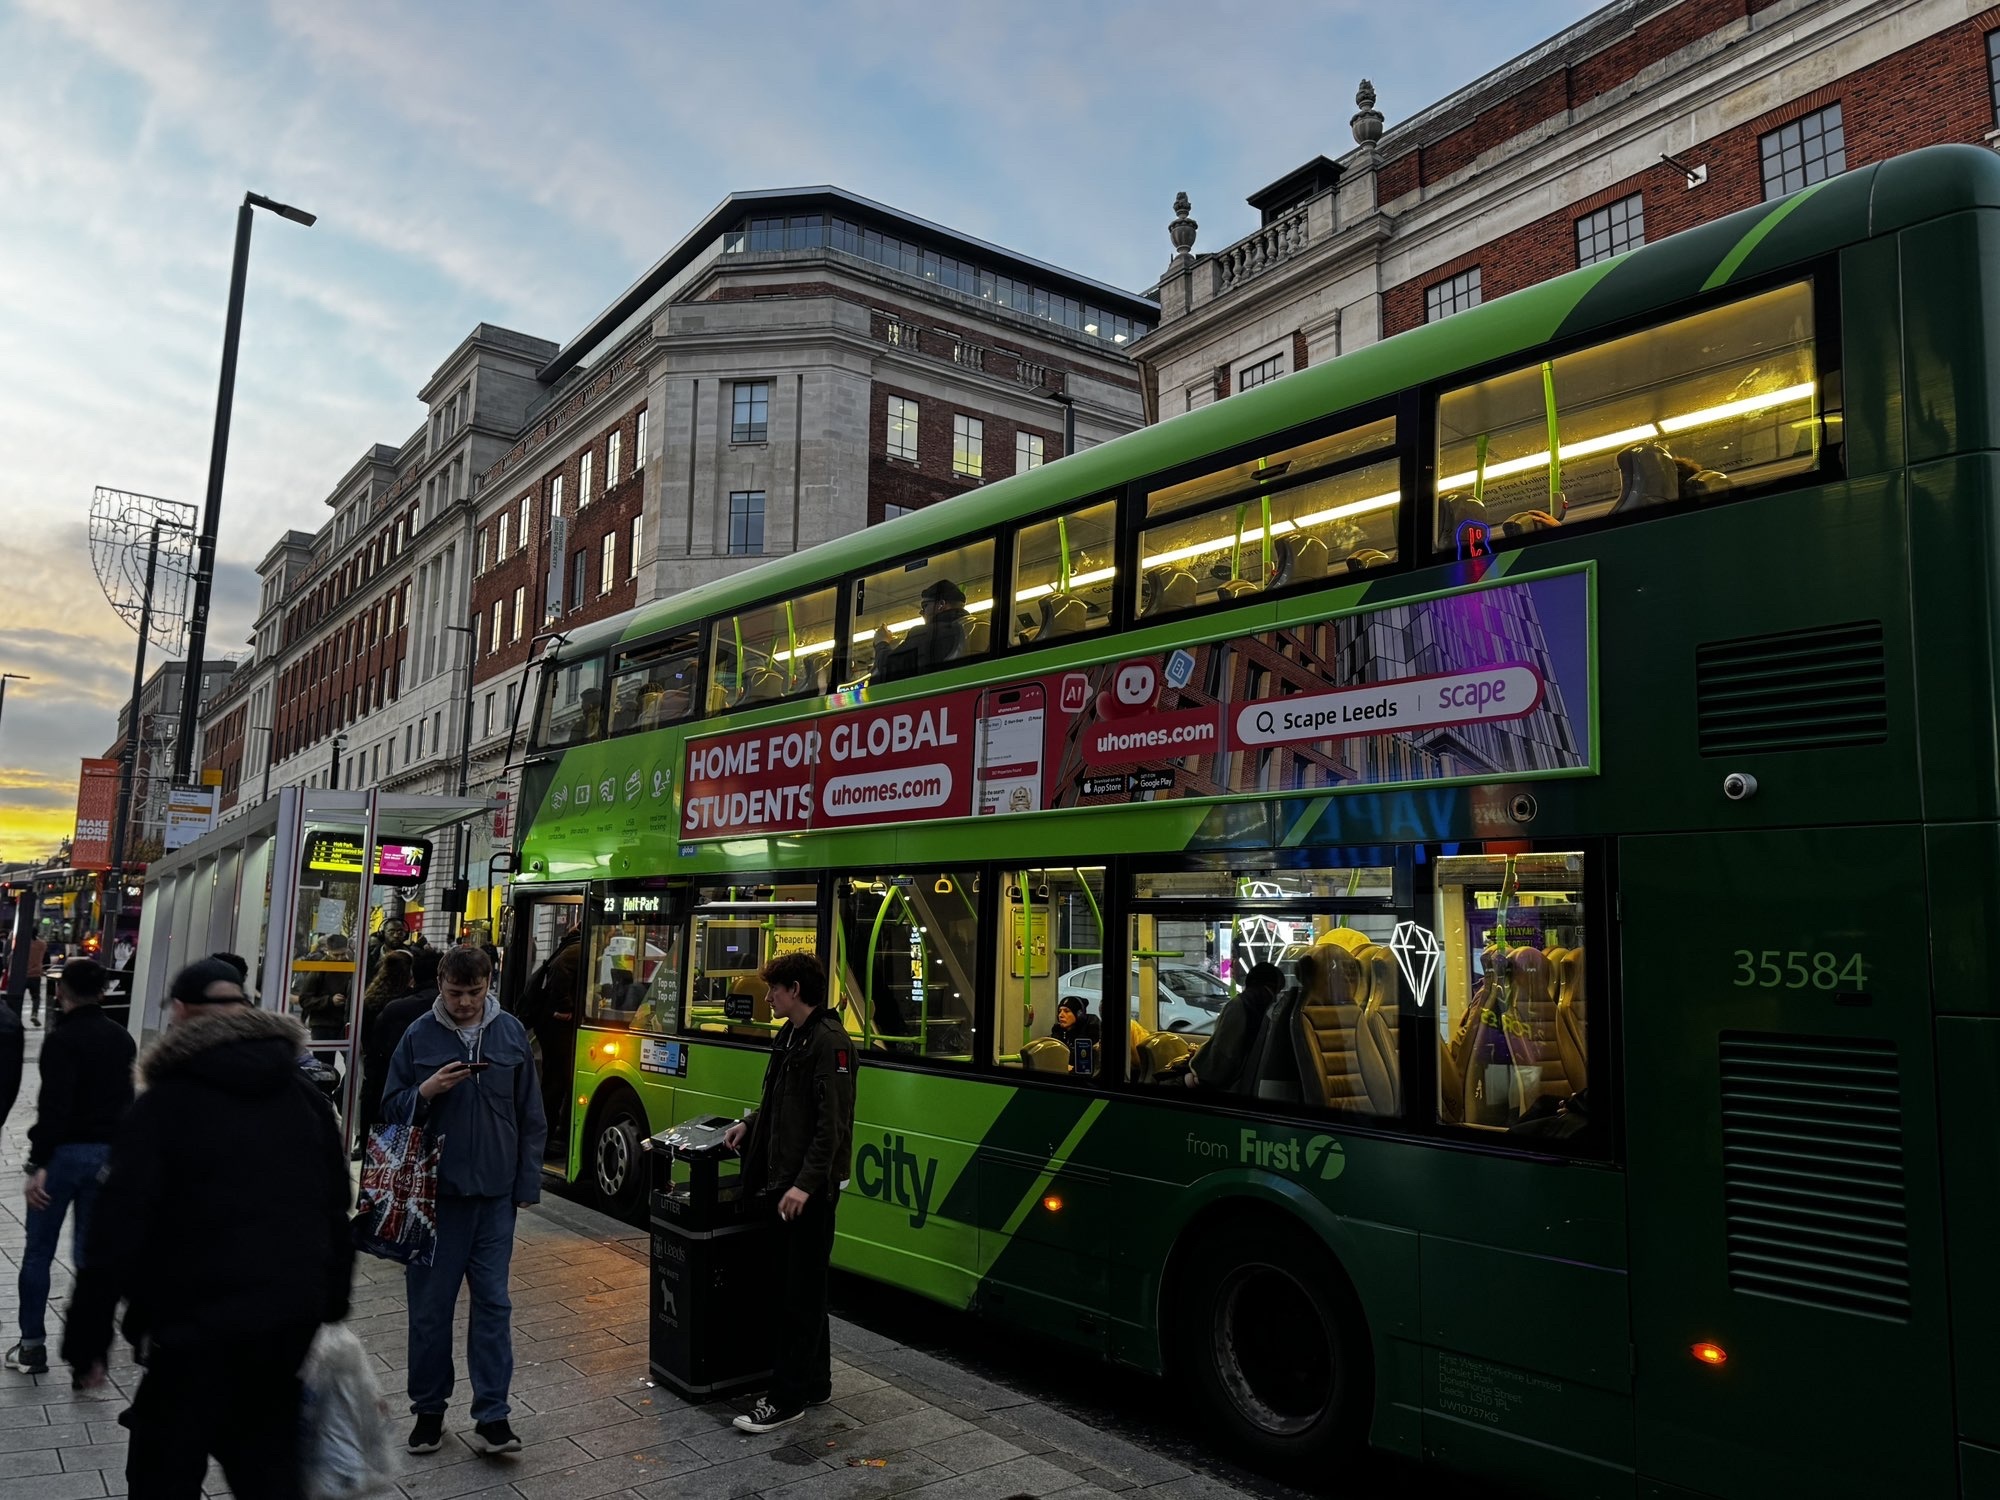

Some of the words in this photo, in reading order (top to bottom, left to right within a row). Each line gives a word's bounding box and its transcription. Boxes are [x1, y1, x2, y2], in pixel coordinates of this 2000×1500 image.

[1519, 470, 1565, 486] Unlimid
[1066, 686, 1082, 701] AI
[1439, 676, 1506, 715] scape
[1283, 706, 1337, 731] Scape
[1341, 698, 1398, 723] Leeds
[689, 739, 762, 782] HOME
[766, 729, 822, 771] FOR
[829, 707, 958, 763] GLOBAL
[1097, 723, 1214, 752] uhomes.com
[831, 773, 941, 807] uhomes.com
[1093, 785, 1105, 794] App
[1106, 783, 1121, 792] Store
[1140, 779, 1159, 788] Google
[1160, 777, 1172, 786] Play
[685, 782, 814, 831] STUDENTS
[77, 827, 109, 835] MORE
[78, 819, 110, 828] MAKE
[603, 897, 615, 912] 23
[623, 897, 639, 912] Holt
[639, 896, 660, 911] Park
[774, 934, 804, 945] Cheaper
[1733, 949, 1869, 991] 35584
[658, 977, 668, 990] Tap
[658, 990, 668, 1003] Tap
[668, 991, 677, 1001] off
[1186, 1132, 1229, 1160] from
[1240, 1128, 1301, 1172] First
[856, 1132, 938, 1229] city
[660, 1197, 681, 1215] LITTER
